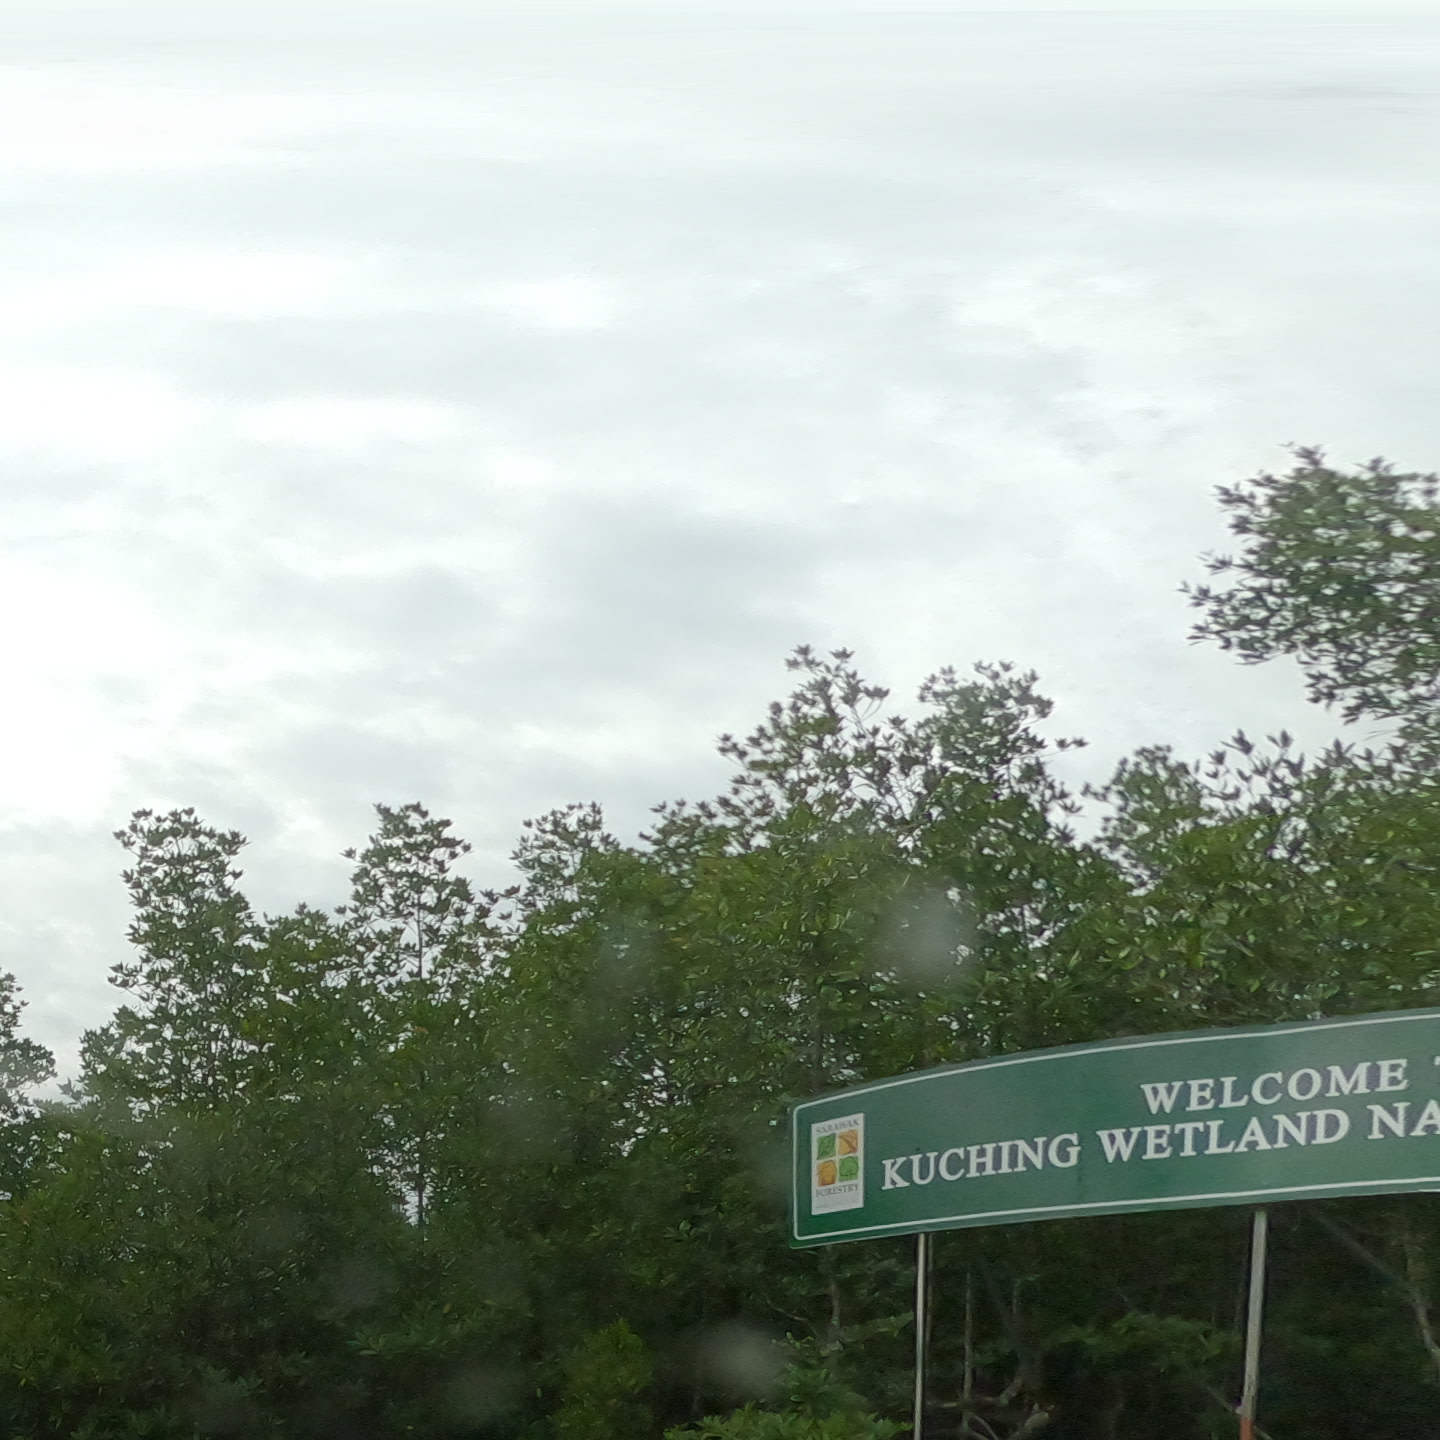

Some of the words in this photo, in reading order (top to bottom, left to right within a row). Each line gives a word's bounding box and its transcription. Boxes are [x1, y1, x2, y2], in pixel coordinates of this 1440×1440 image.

[1141, 1058, 1408, 1115] WELCOME
[881, 1133, 1081, 1190] KUCHING
[1097, 1109, 1349, 1164] WETLAND
[815, 1184, 859, 1198] FORESTRY
